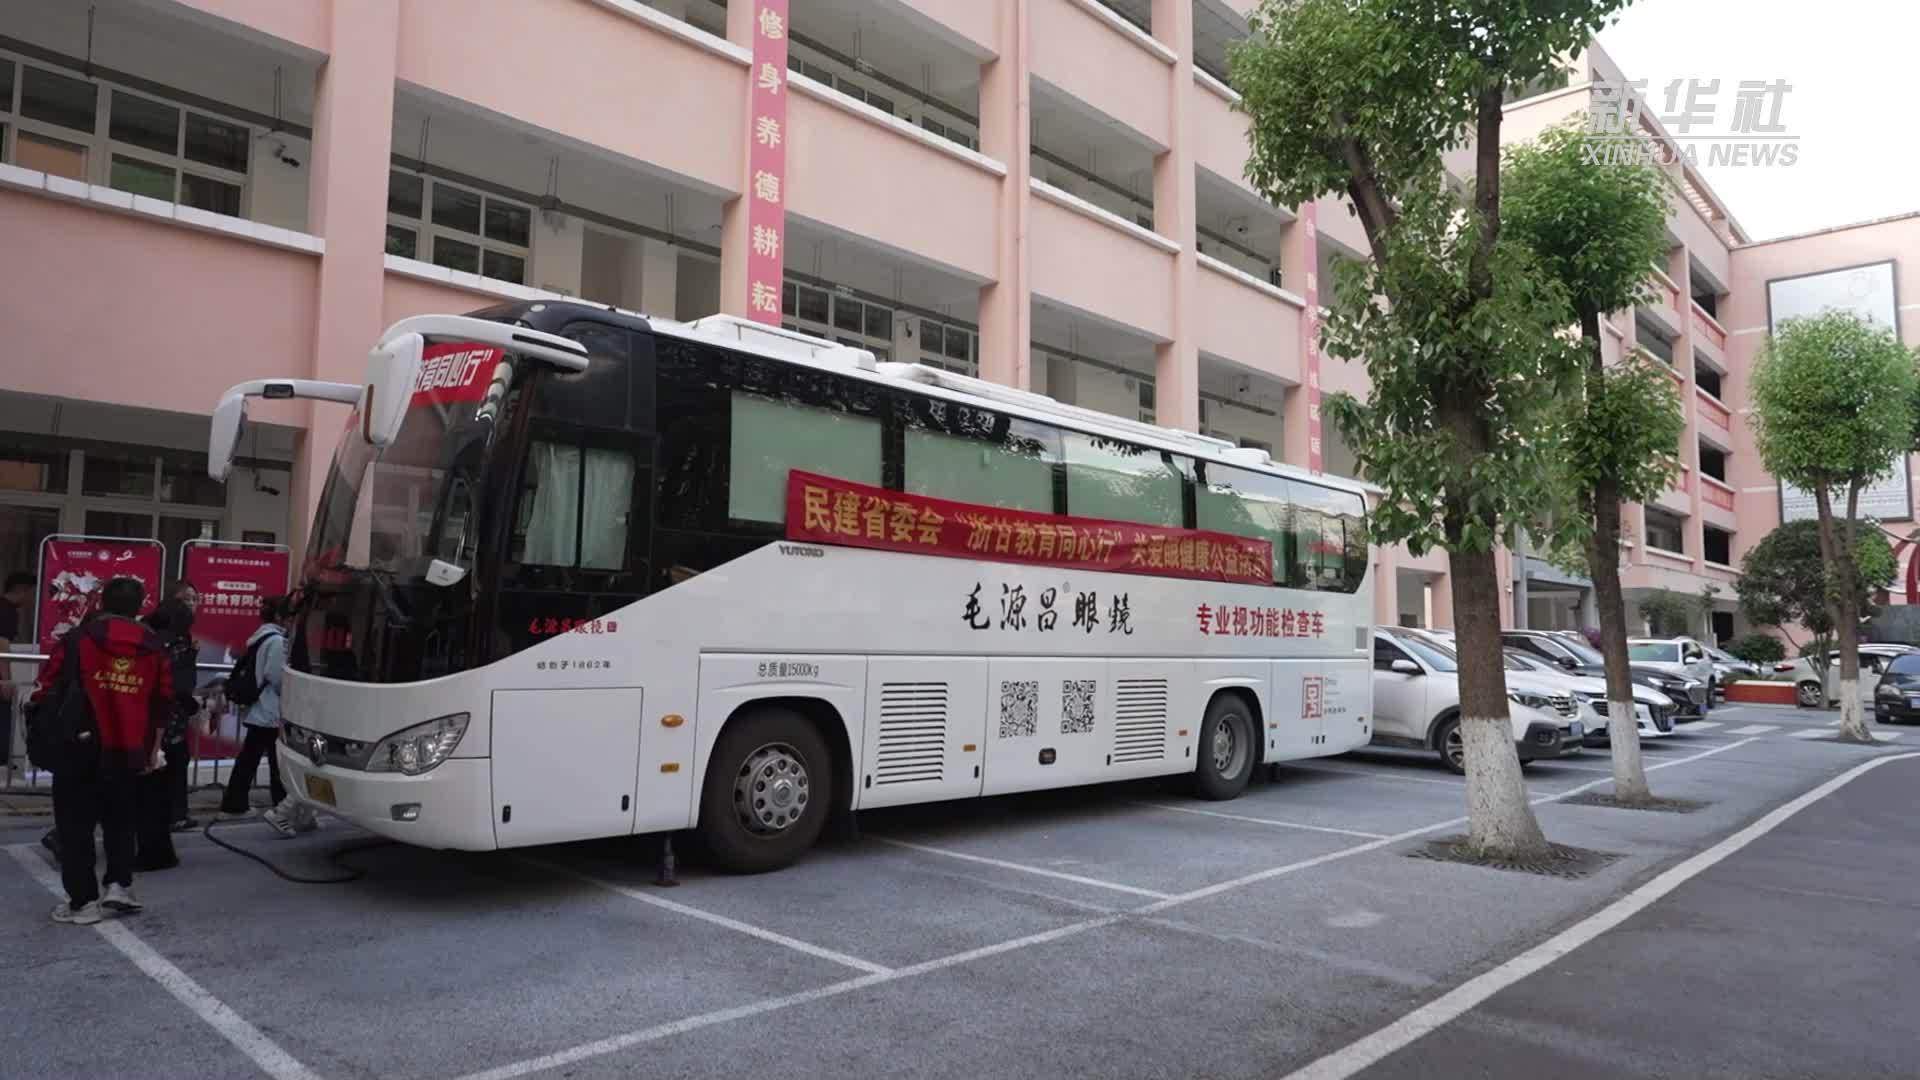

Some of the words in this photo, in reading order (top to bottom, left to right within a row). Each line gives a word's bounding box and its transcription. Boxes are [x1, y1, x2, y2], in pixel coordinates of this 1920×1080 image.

[752, 8, 784, 313] 修身养德耕耘
[803, 485, 945, 545] 民建省委会
[778, 544, 825, 558] YUTONG
[1196, 603, 1325, 639] 专业视功能检查车
